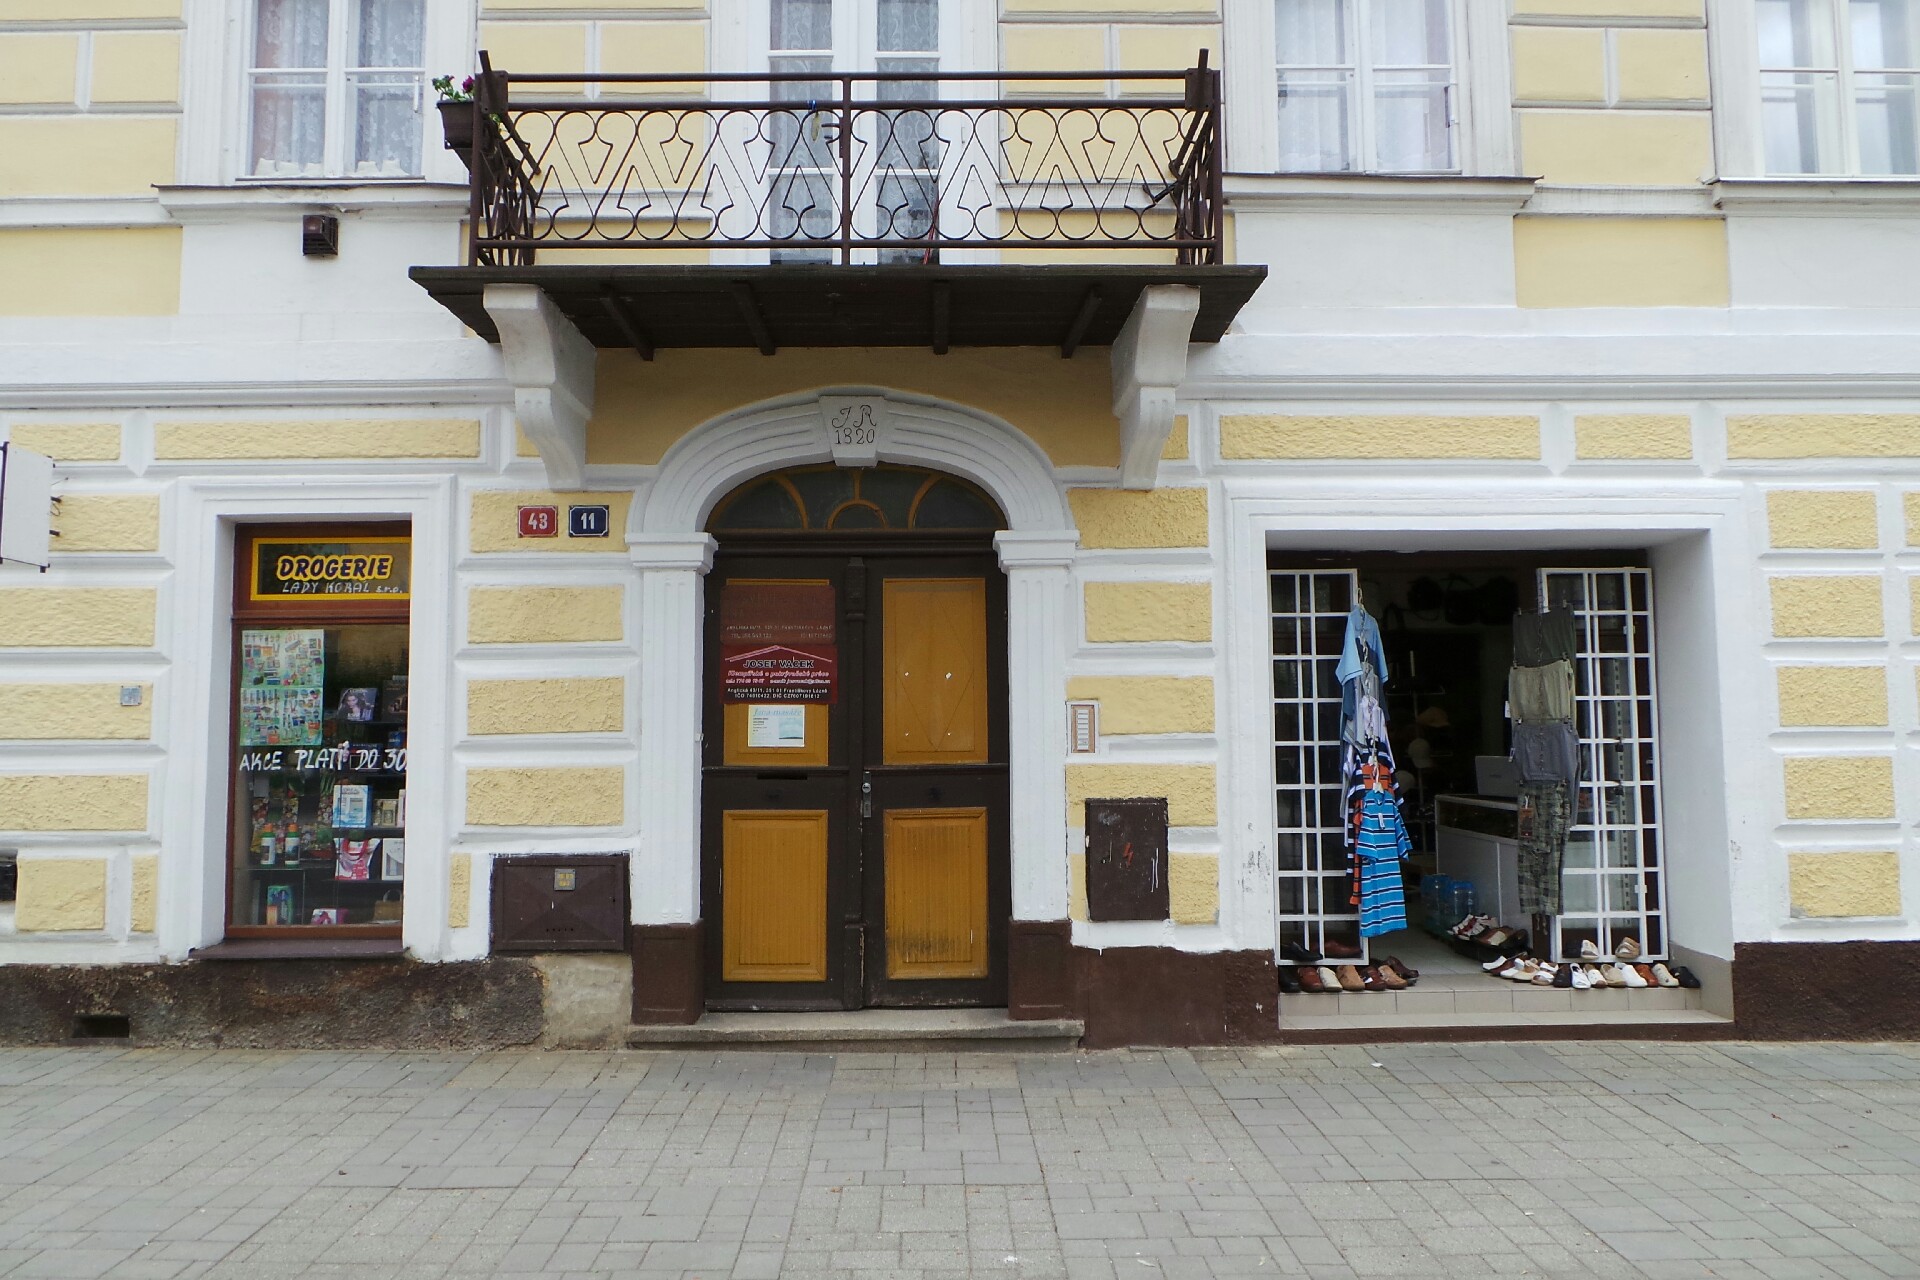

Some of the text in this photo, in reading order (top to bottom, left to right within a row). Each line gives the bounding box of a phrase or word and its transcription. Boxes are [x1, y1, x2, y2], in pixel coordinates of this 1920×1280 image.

[835, 427, 875, 445] 1820
[528, 512, 548, 530] 43
[580, 512, 595, 530] 11
[278, 556, 392, 580] DROGERIE
[282, 581, 319, 594] LADY
[743, 659, 777, 669] JOSEF
[239, 750, 283, 771] AKCE
[355, 749, 379, 771] DO
